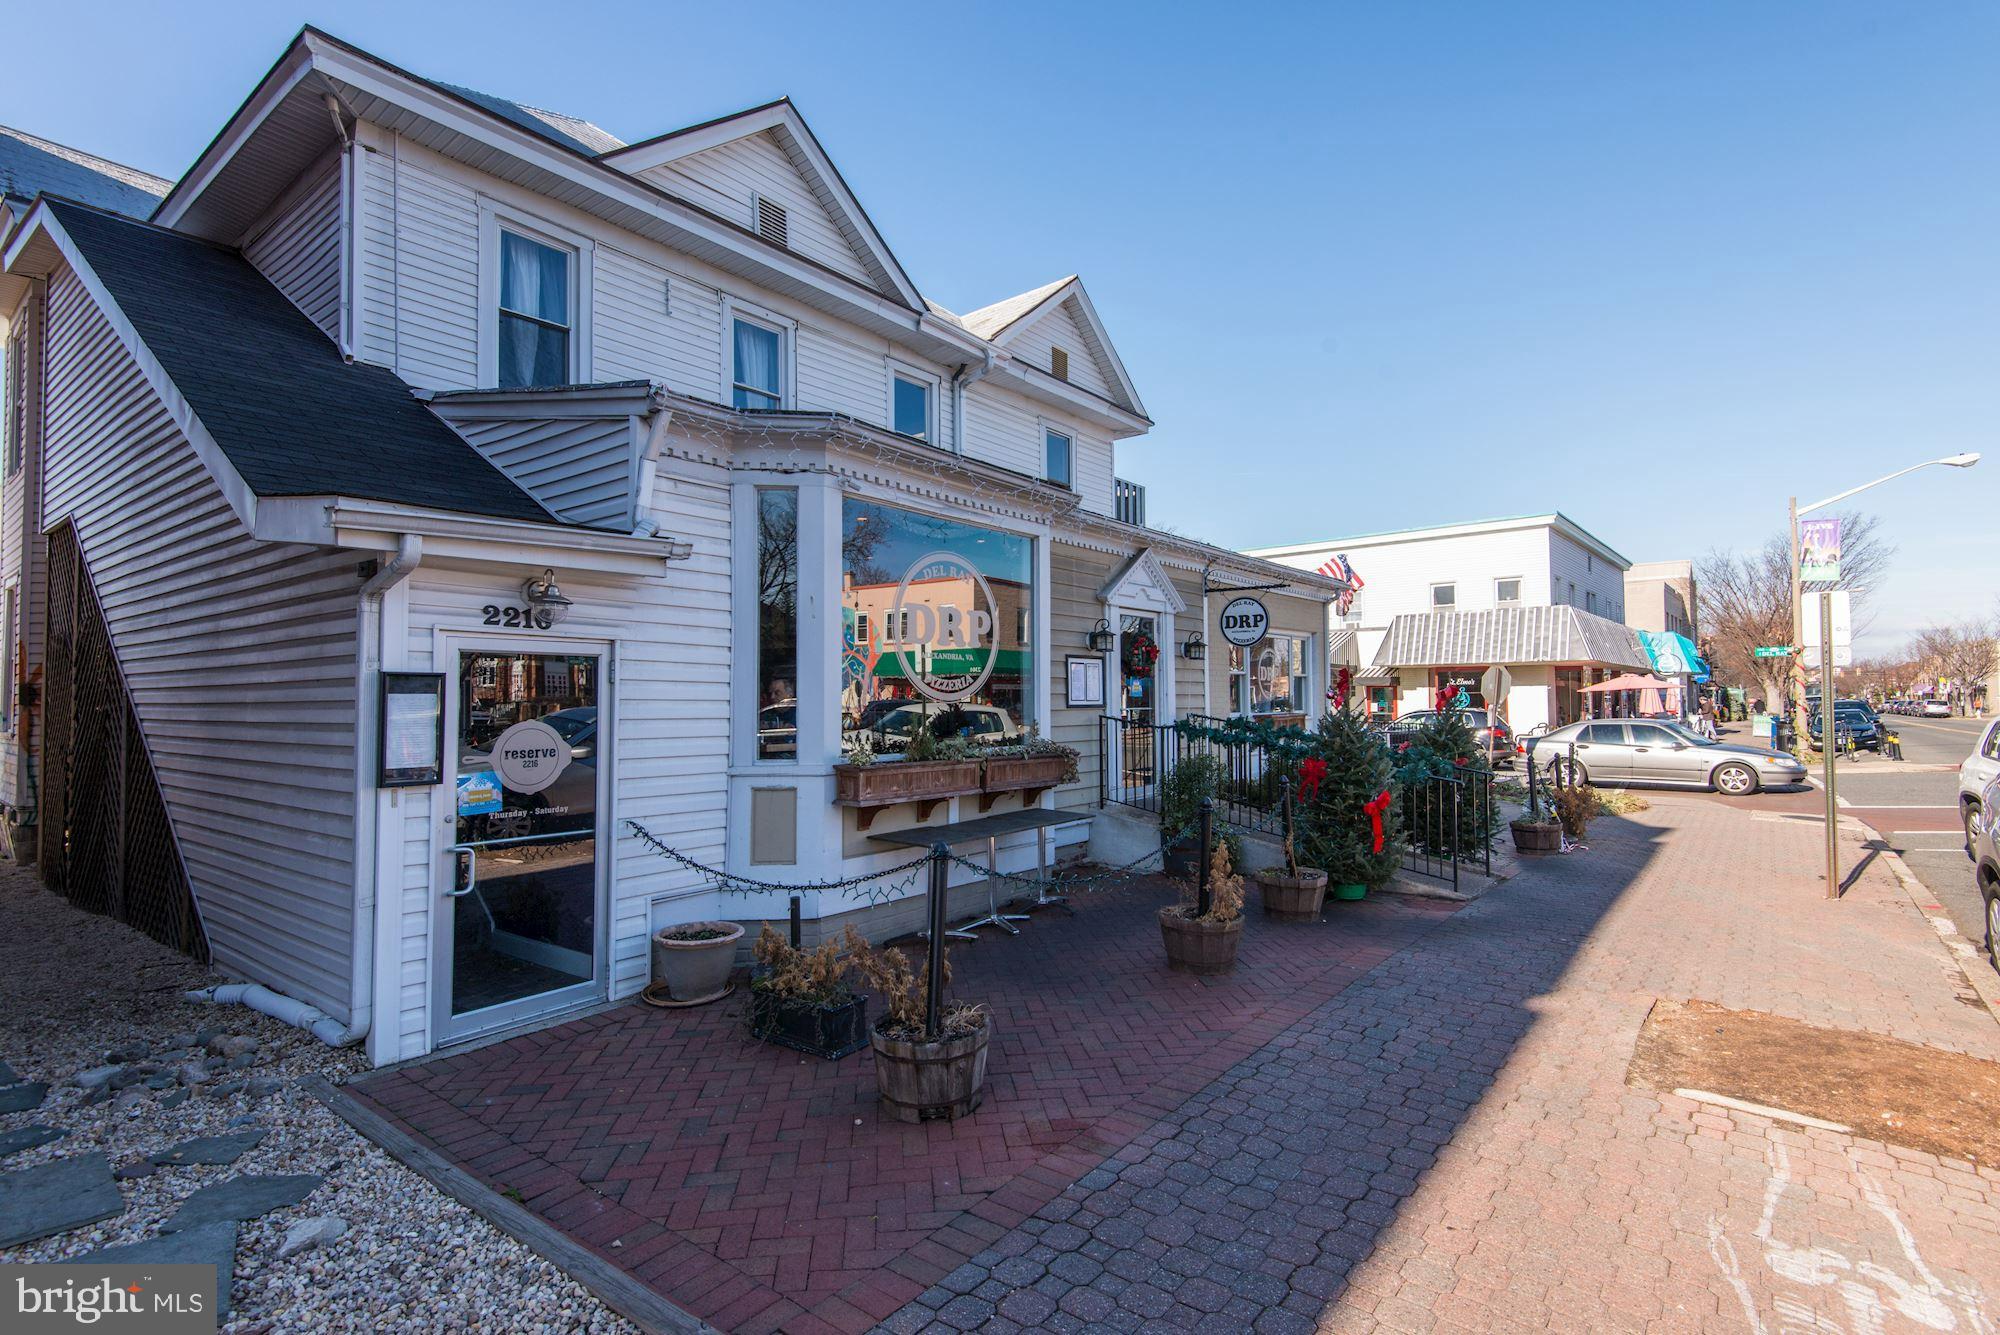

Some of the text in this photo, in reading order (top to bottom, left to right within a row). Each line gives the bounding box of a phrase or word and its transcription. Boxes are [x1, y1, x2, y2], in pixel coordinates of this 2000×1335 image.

[923, 565, 946, 579] DEL
[904, 603, 992, 648] DRP
[1225, 614, 1264, 629] DRP
[504, 748, 556, 760] reserve
[522, 760, 539, 769] 2216
[489, 808, 527, 820] Thursday
[534, 805, 569, 816] Saturday
